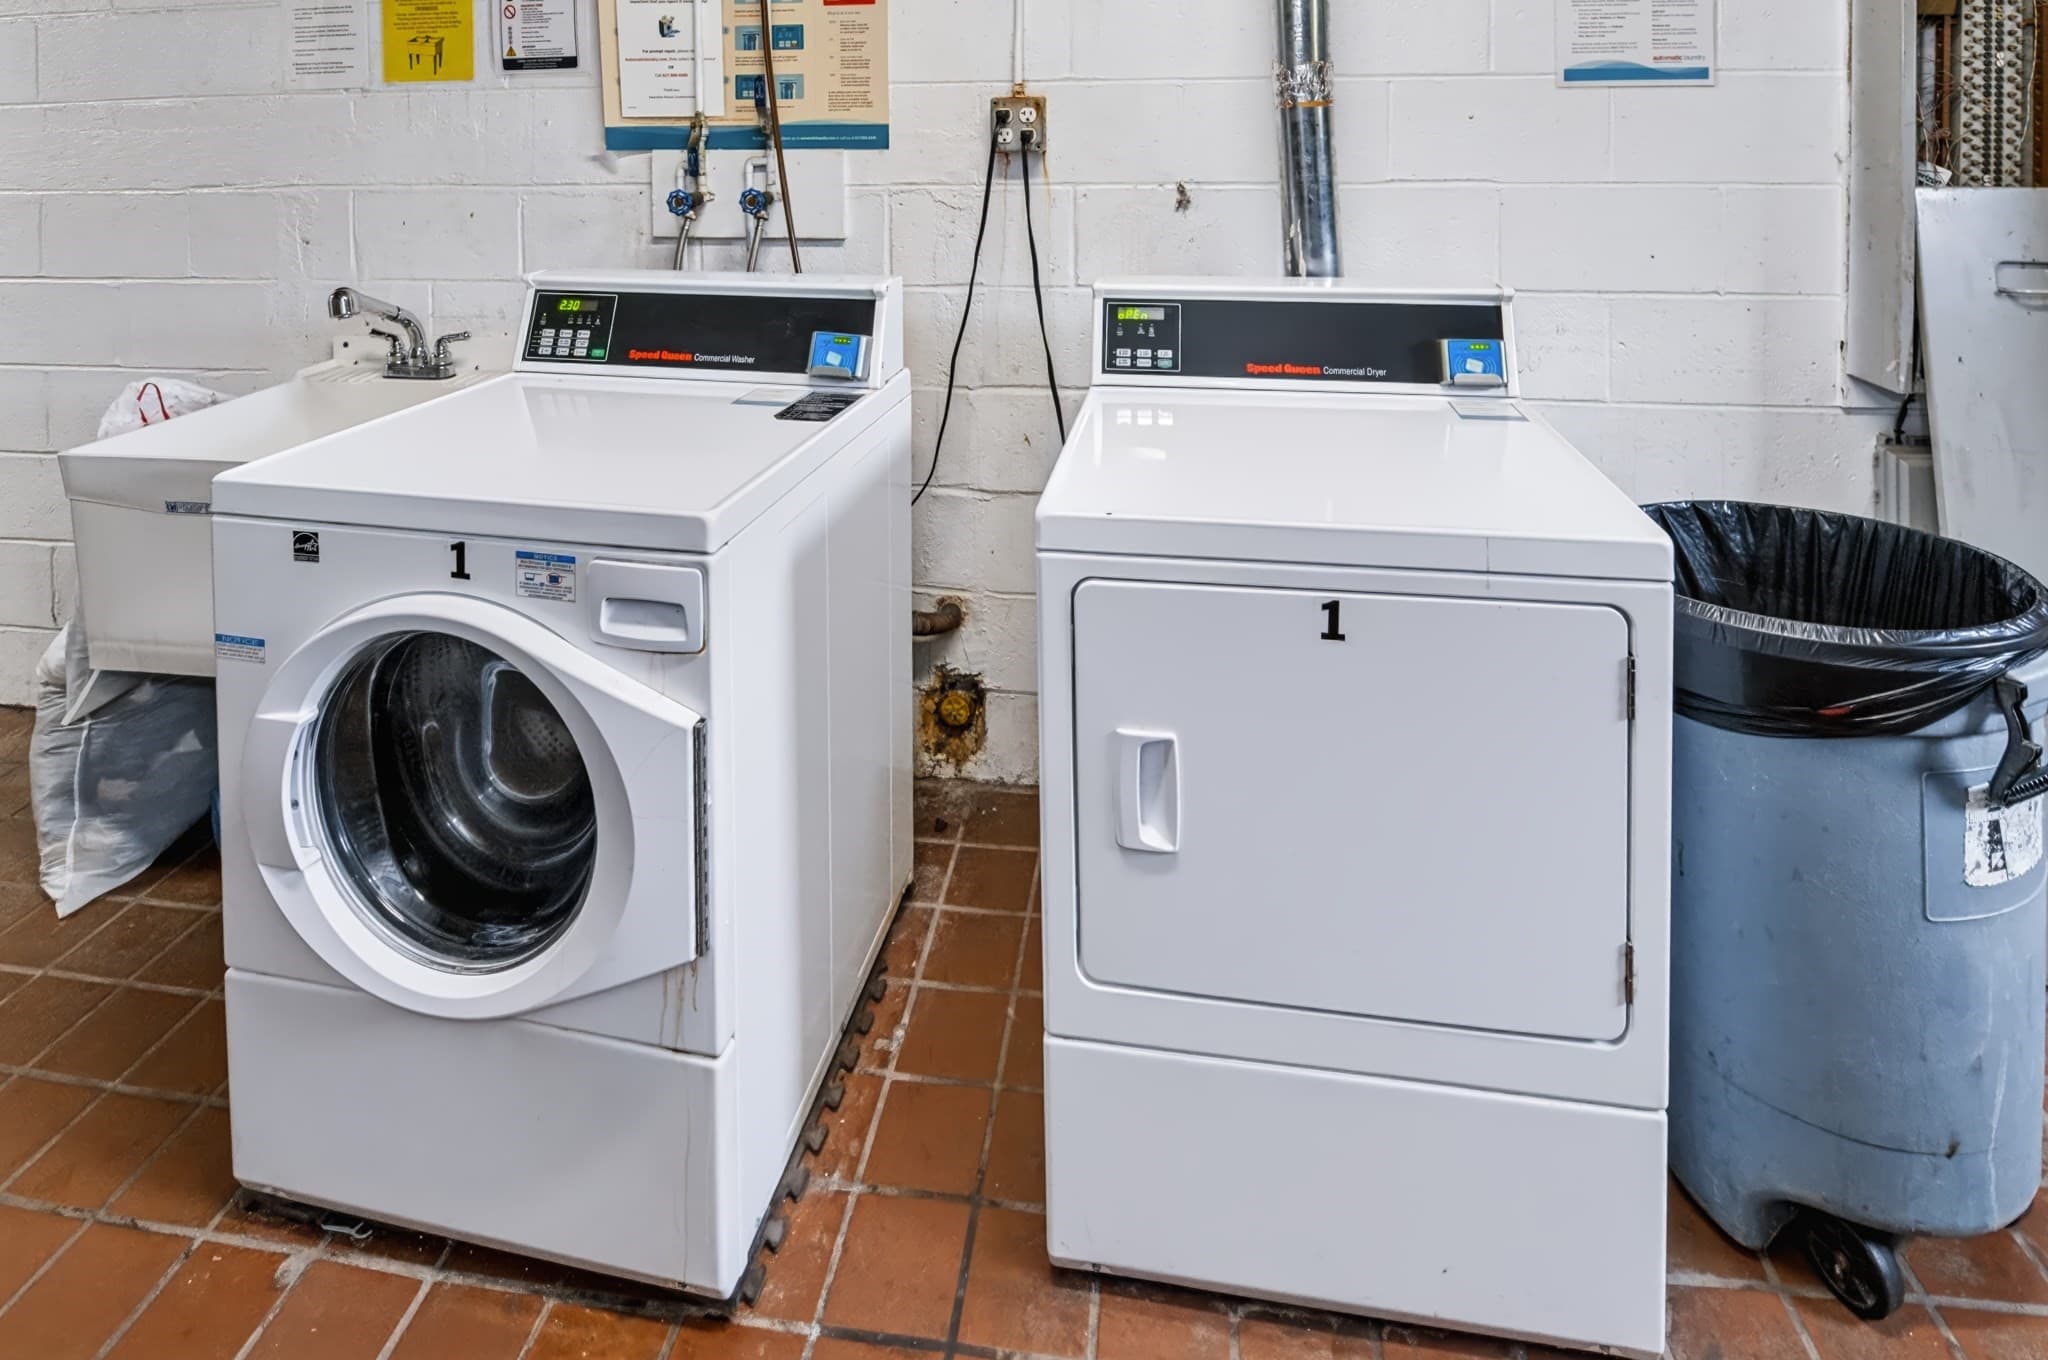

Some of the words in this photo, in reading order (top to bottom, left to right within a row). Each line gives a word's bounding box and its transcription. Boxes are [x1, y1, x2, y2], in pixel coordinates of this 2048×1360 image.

[628, 349, 660, 361] Speed
[661, 350, 693, 361] Queen
[694, 353, 731, 363] Commercial
[731, 355, 756, 364] Washer
[1246, 363, 1283, 375] Speed
[1284, 364, 1321, 375] Queen
[1323, 366, 1365, 376] Commercial
[1366, 367, 1387, 378] Dryer
[450, 541, 471, 580] 1
[1321, 599, 1346, 642] 1
